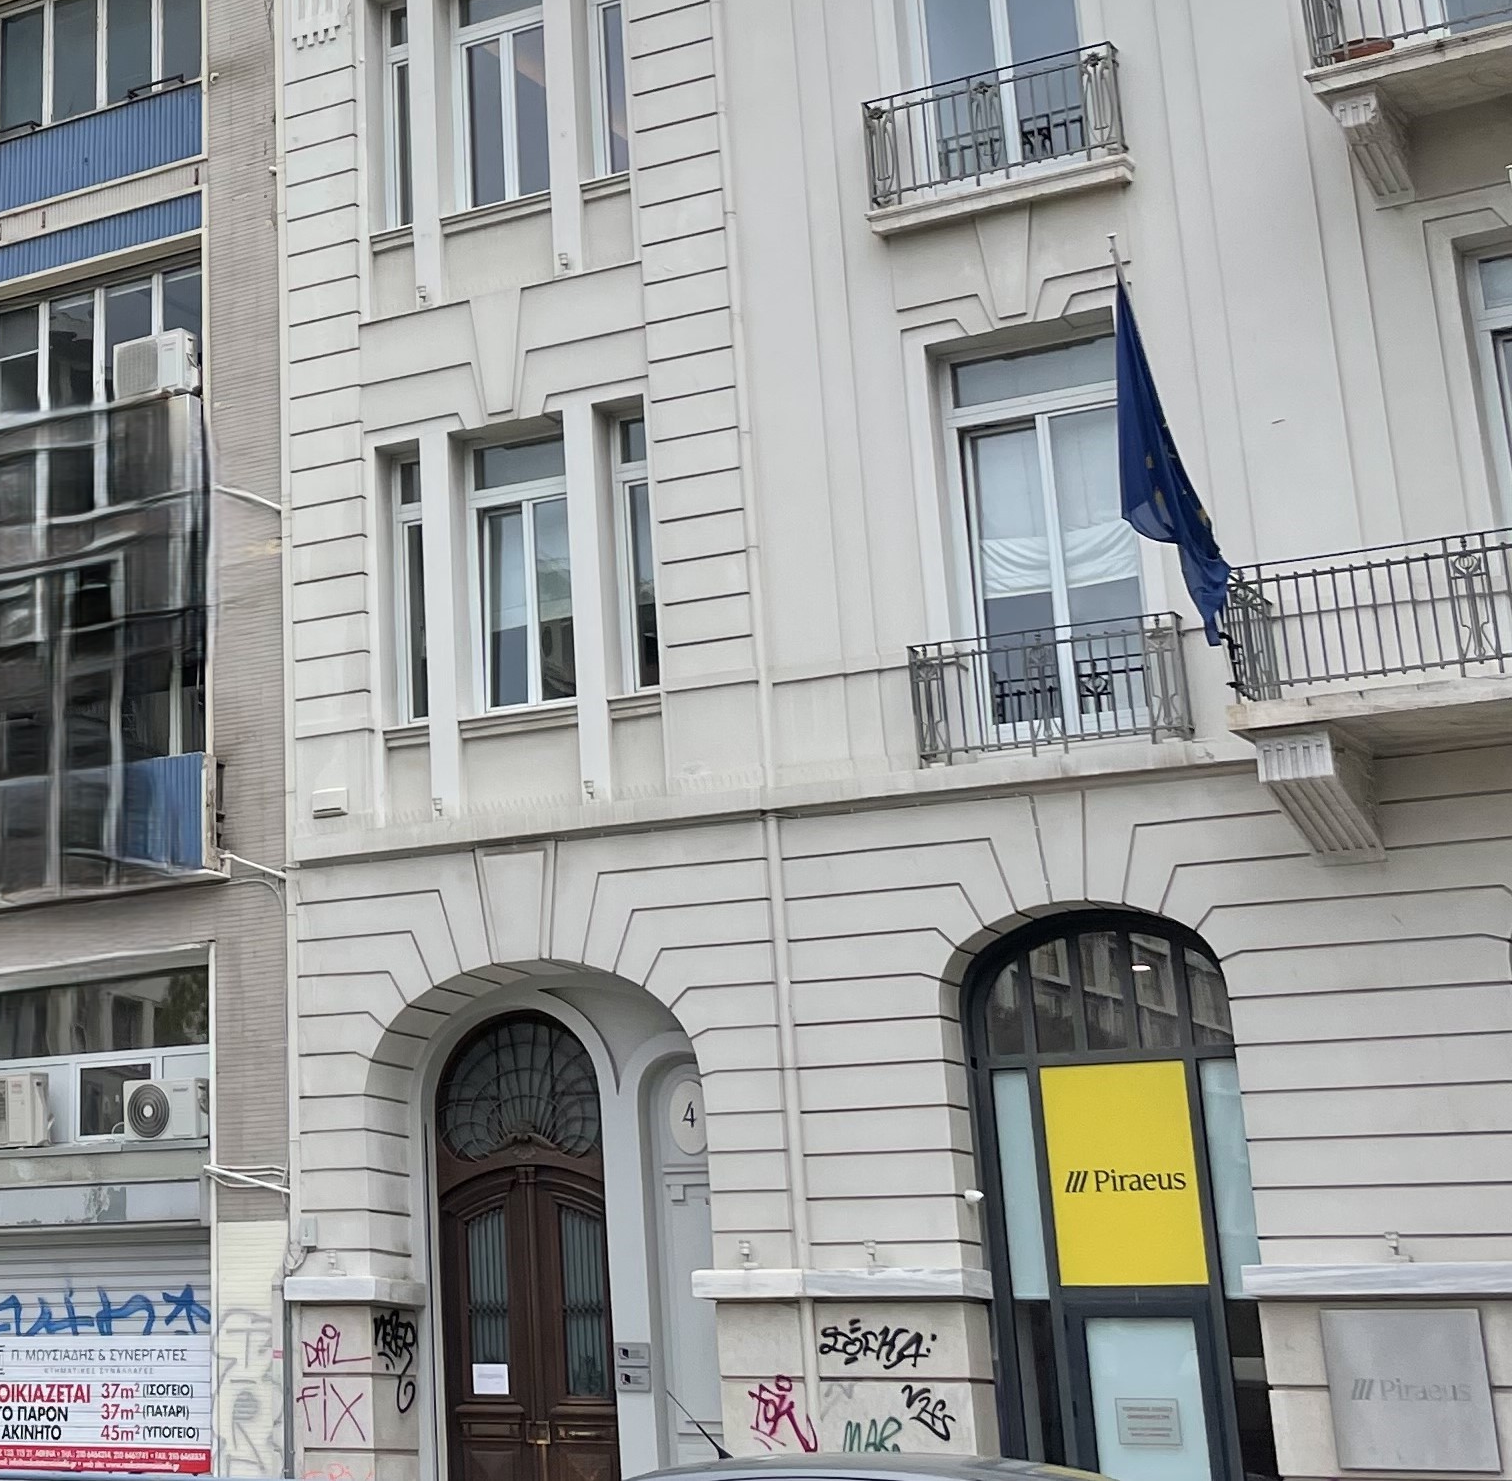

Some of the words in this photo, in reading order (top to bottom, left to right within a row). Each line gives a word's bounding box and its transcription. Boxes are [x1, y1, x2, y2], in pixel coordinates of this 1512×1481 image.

[682, 1101, 697, 1128] 4
[1093, 1169, 1187, 1192] Piraeus
[98, 1350, 106, 1361] &
[109, 1348, 188, 1361] ΣΥΝΕΡΓΑΤΕΣ
[142, 1384, 194, 1399] (ΙΣΟΓΕΙΟ)
[1379, 1378, 1473, 1401] Piraeus
[17, 1406, 69, 1421] ΠΑΡΟΝ
[142, 1405, 190, 1419] (ΠΑΤΑΡΙ)
[1, 1425, 62, 1440] ΑΚΙΝΗΤΟ
[142, 1426, 200, 1440] (ΥΠΟΓΕΙΟ)
